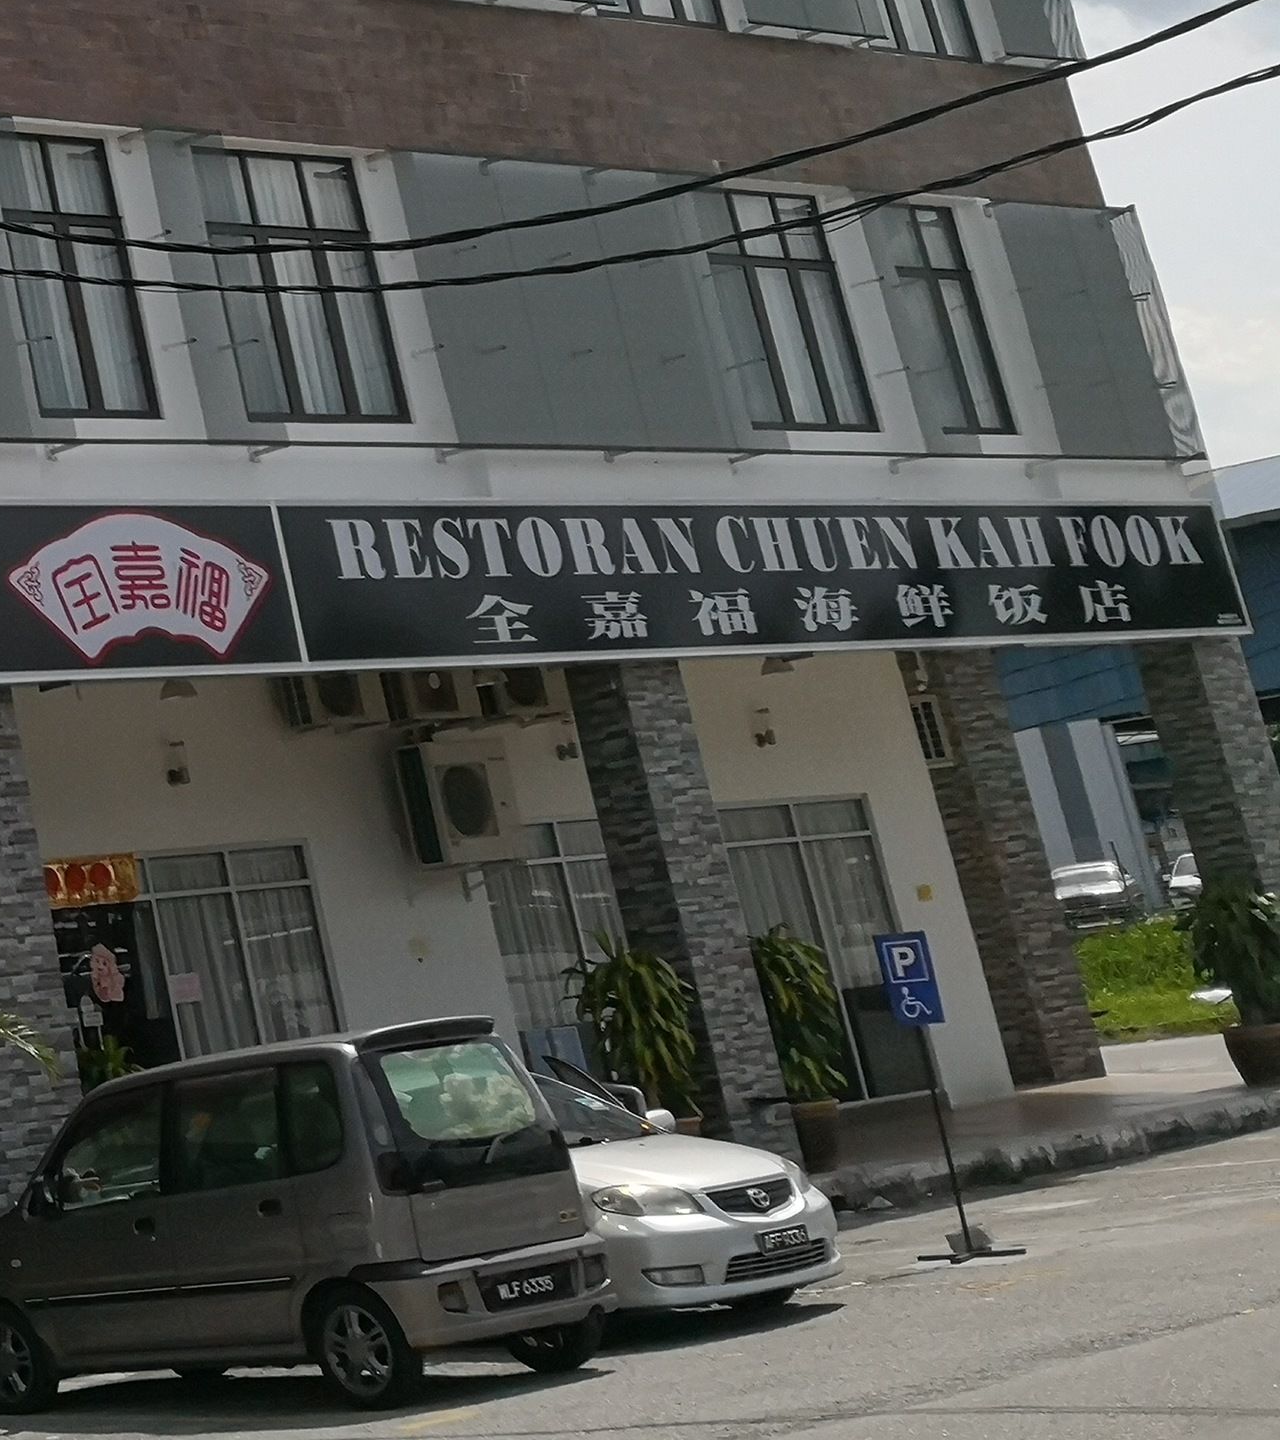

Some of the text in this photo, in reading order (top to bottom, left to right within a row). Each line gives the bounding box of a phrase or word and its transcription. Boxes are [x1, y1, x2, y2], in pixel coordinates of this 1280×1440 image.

[325, 513, 1204, 581] RESTORAN CHUEN KAH FOOK
[464, 579, 1133, 645] 全嘉福海鲜饭店
[891, 946, 917, 977] P
